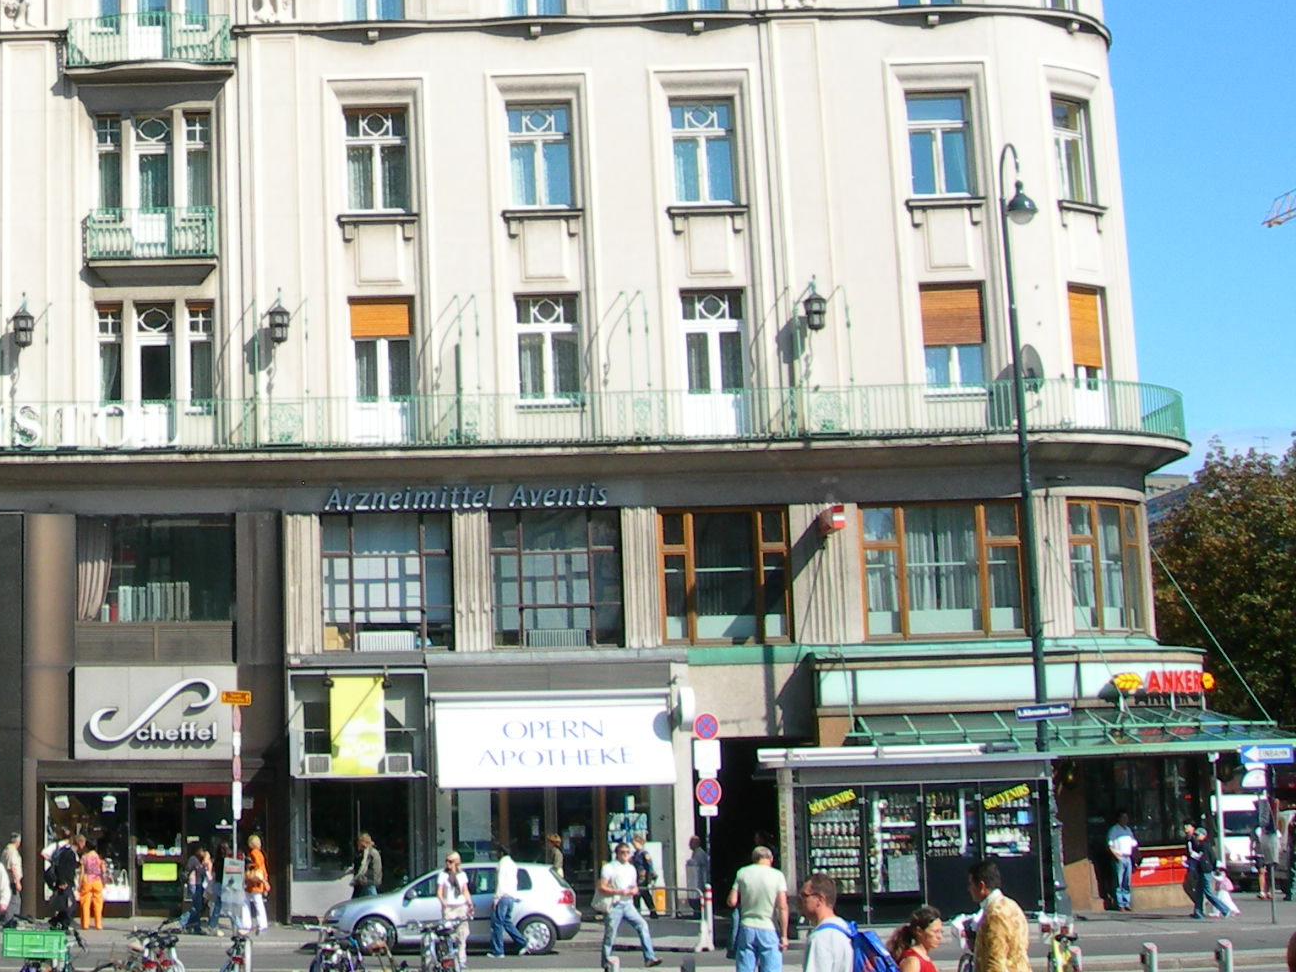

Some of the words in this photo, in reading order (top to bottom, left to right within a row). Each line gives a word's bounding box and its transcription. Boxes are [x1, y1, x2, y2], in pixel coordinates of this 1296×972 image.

[324, 485, 494, 511] Arzneimittel
[508, 482, 609, 508] Aventis
[1147, 670, 1204, 695] ANKER
[89, 677, 218, 743] Scheffel
[502, 719, 604, 739] OPERN
[478, 746, 633, 767] APOTHEKE
[809, 788, 857, 816] SOUVENIRS
[983, 783, 1031, 811] SOUVENIRS
